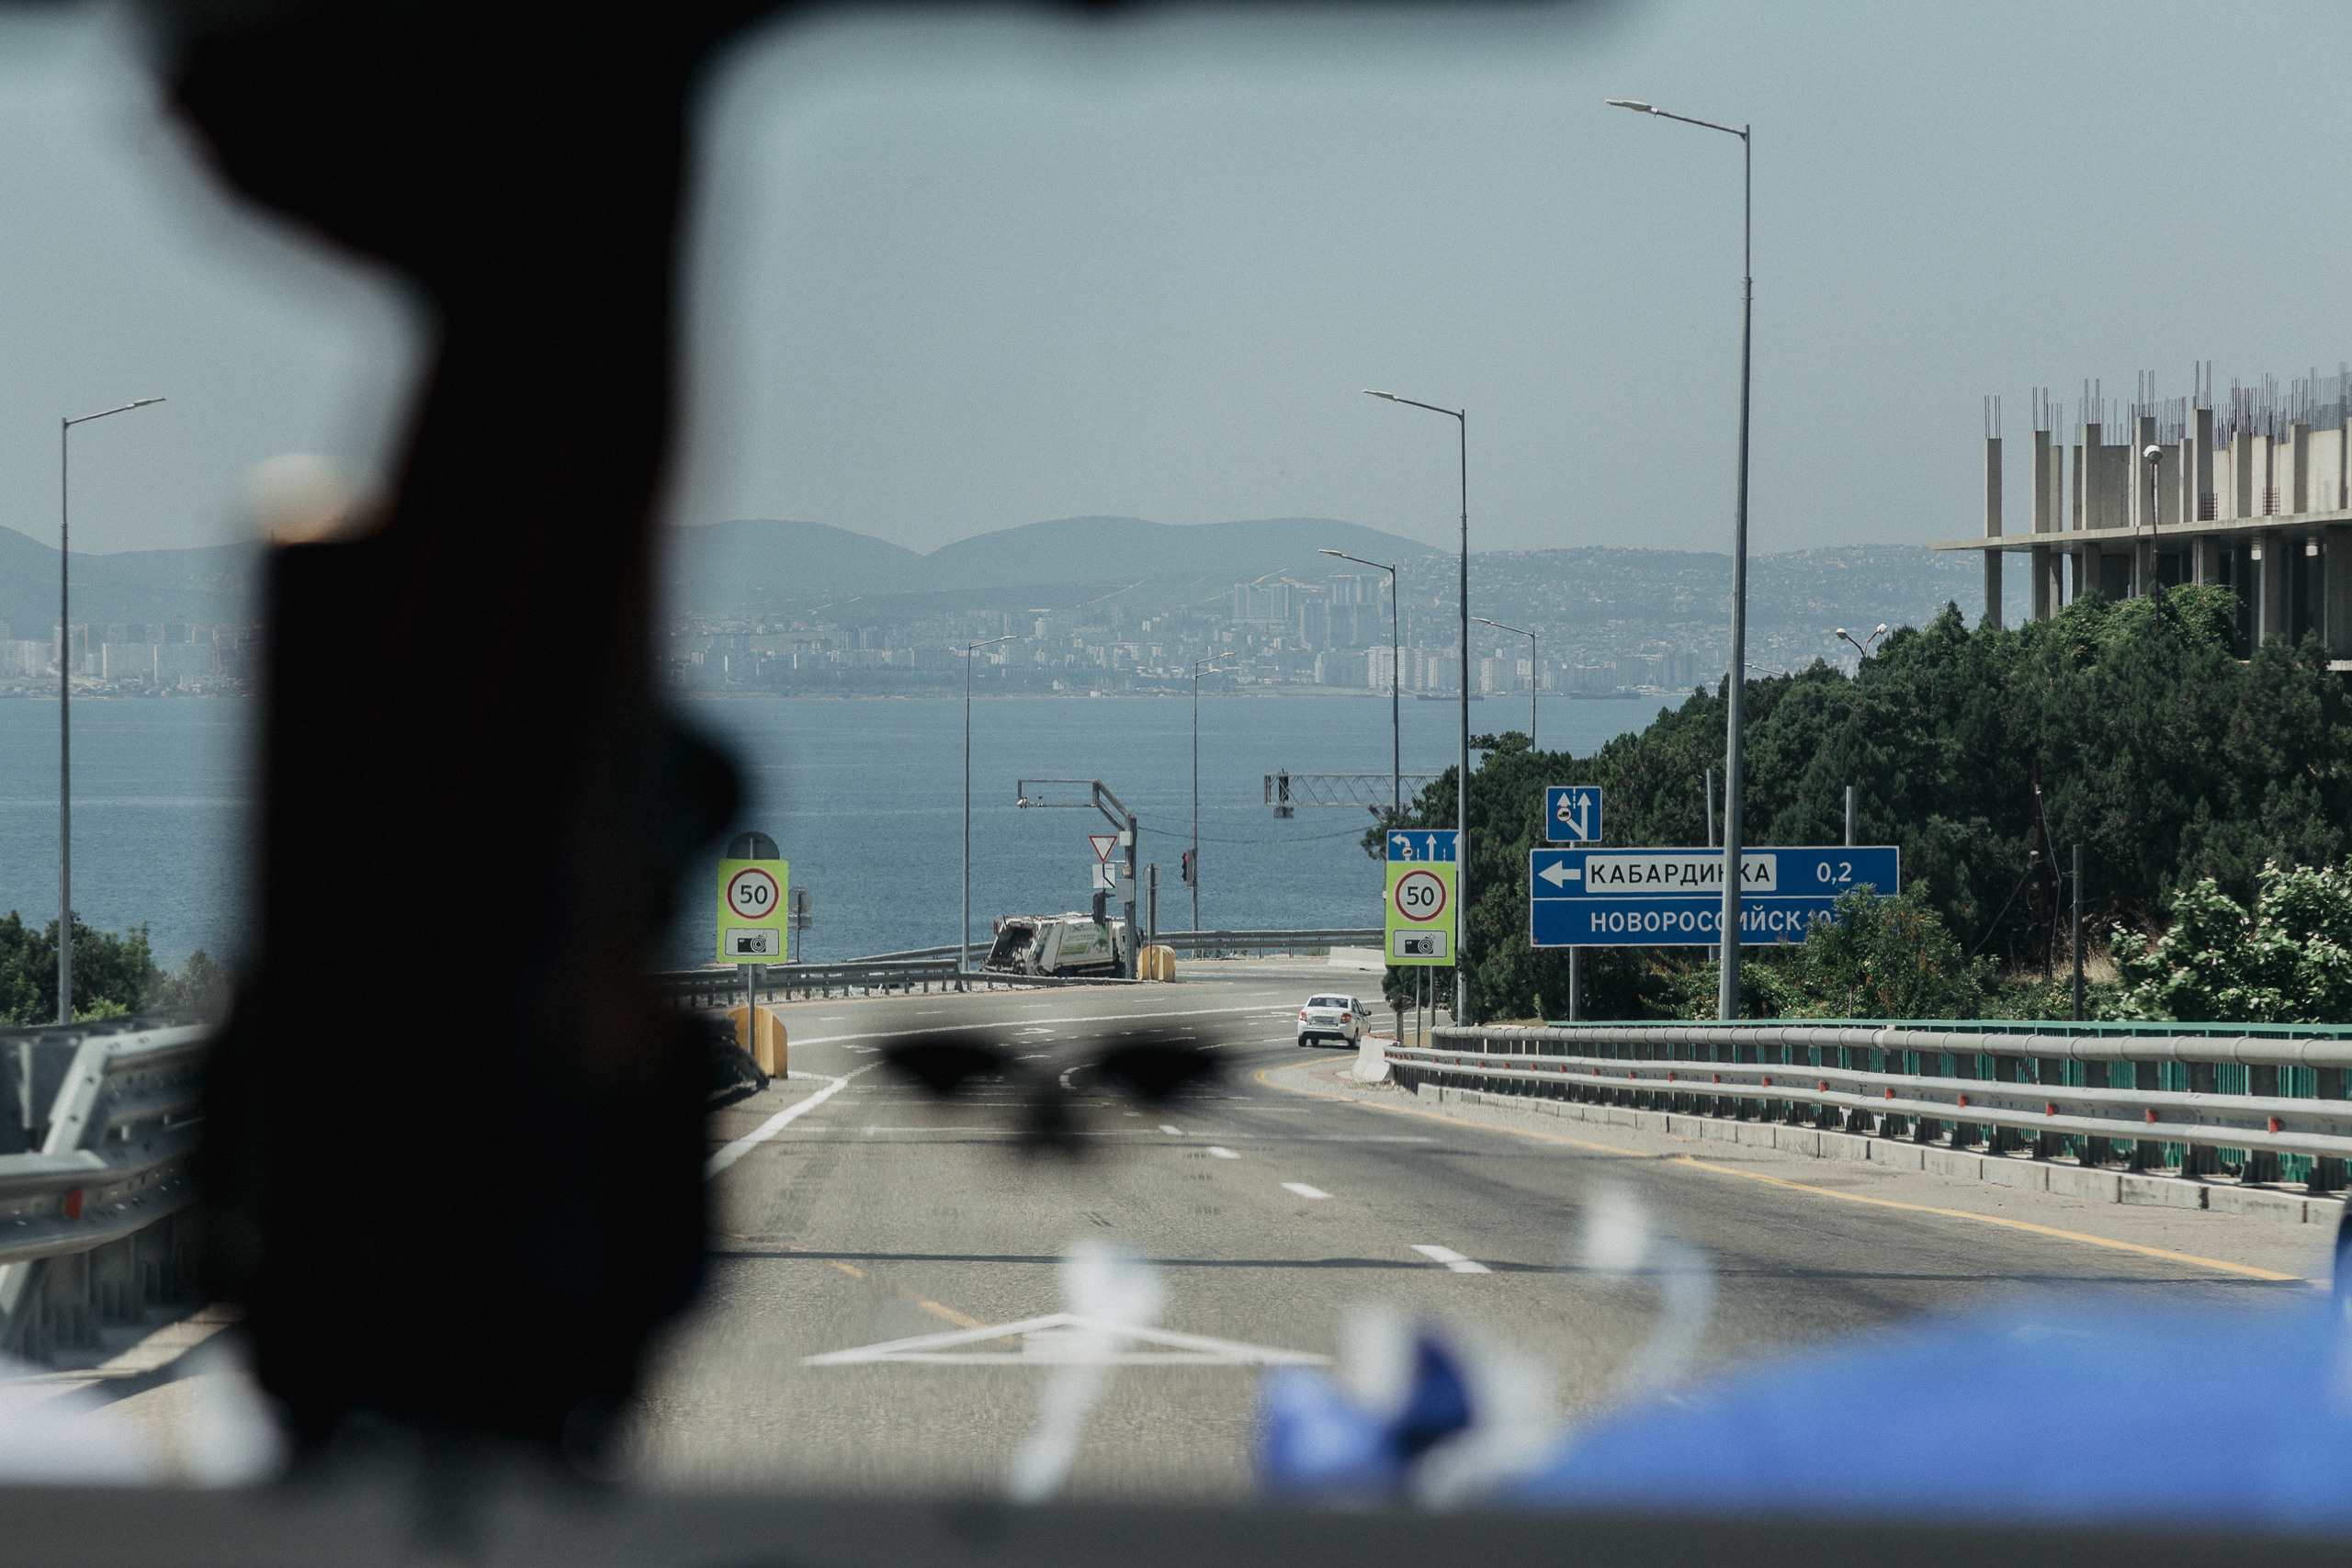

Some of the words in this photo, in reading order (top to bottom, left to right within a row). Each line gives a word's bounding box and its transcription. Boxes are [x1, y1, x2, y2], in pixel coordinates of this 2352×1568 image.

[1816, 862, 1852, 886] 0,2
[740, 885, 768, 905] 50
[1407, 886, 1435, 907] 50
